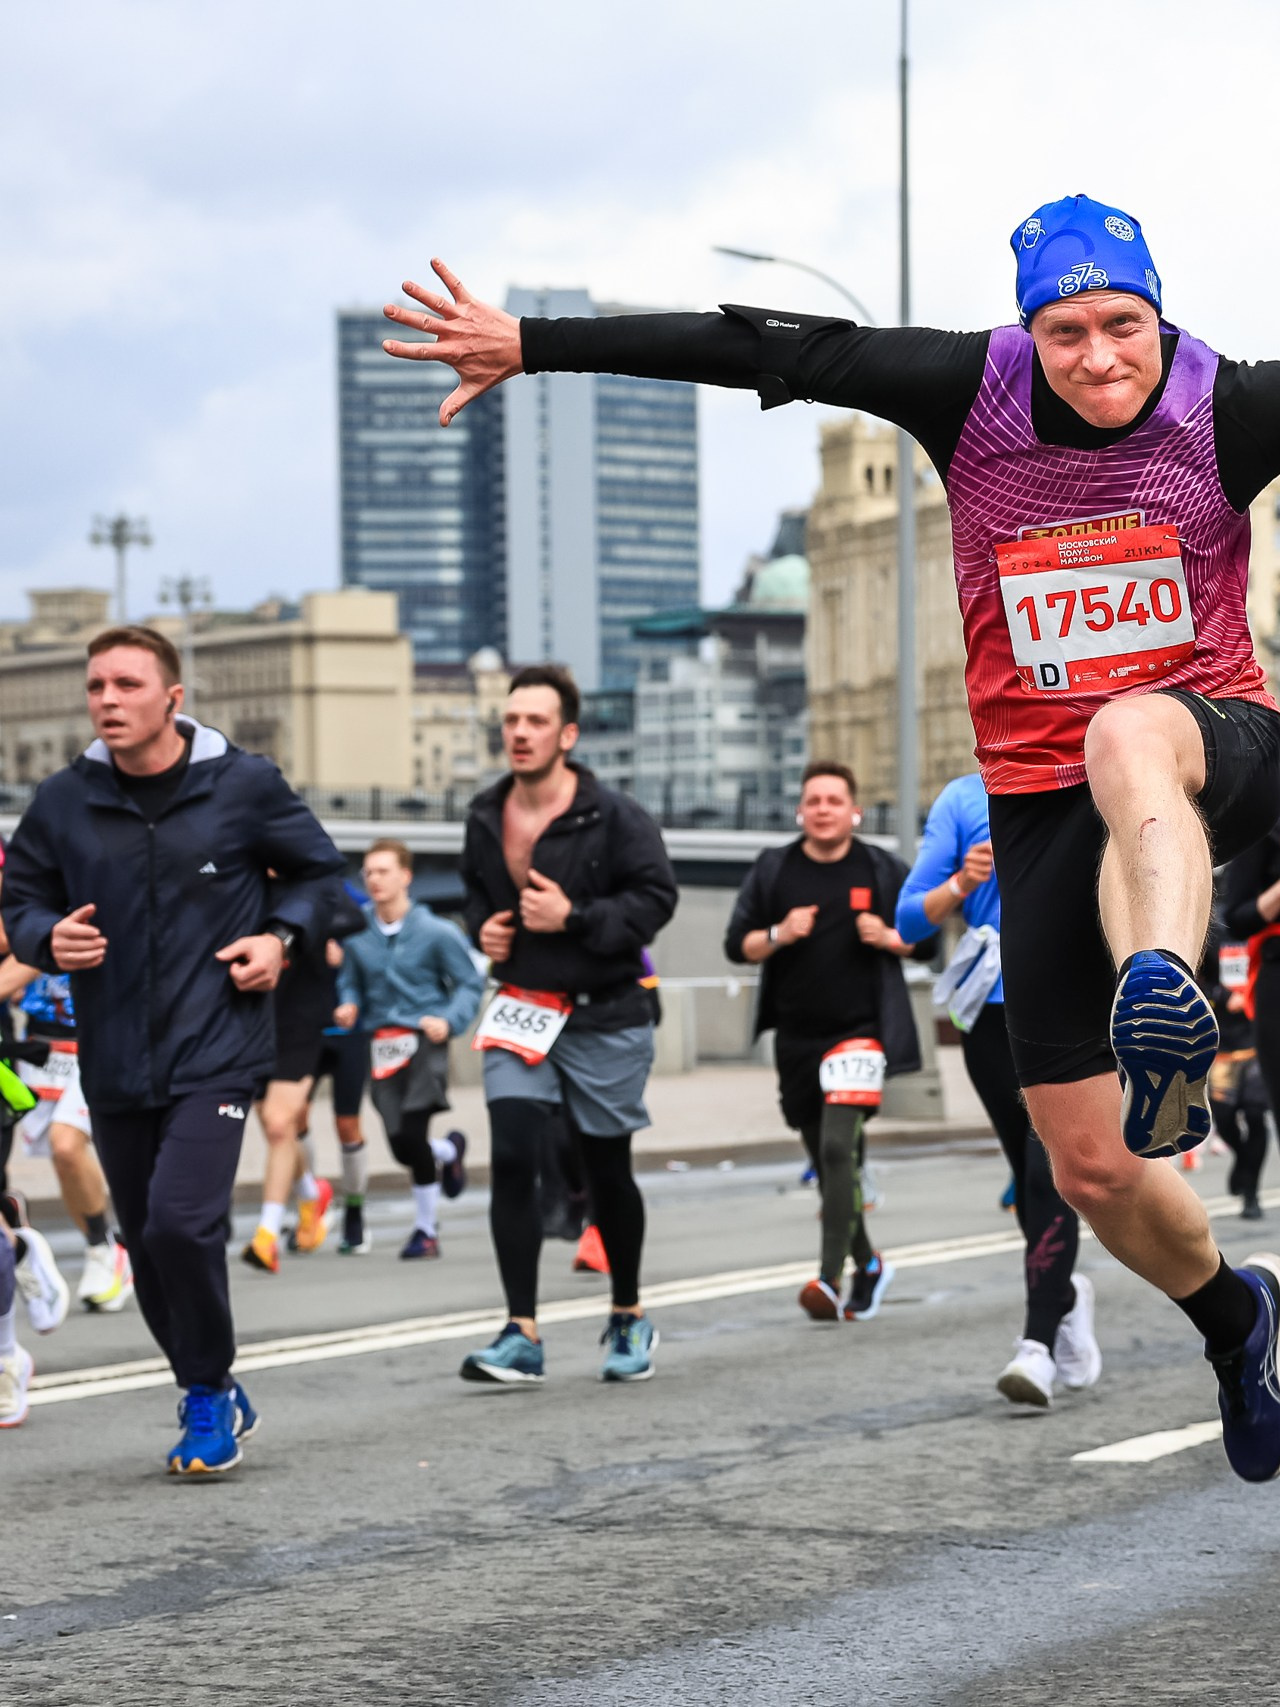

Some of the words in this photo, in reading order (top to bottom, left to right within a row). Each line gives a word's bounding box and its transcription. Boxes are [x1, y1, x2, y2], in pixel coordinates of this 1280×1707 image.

[1058, 262, 1109, 297] 873
[1058, 535, 1118, 550] МОСКОВСКИЙ
[1059, 549, 1082, 558] ПОЛУ
[1060, 554, 1104, 565] МАРАФОН
[1015, 577, 1183, 642] 17540
[1039, 663, 1061, 687] D
